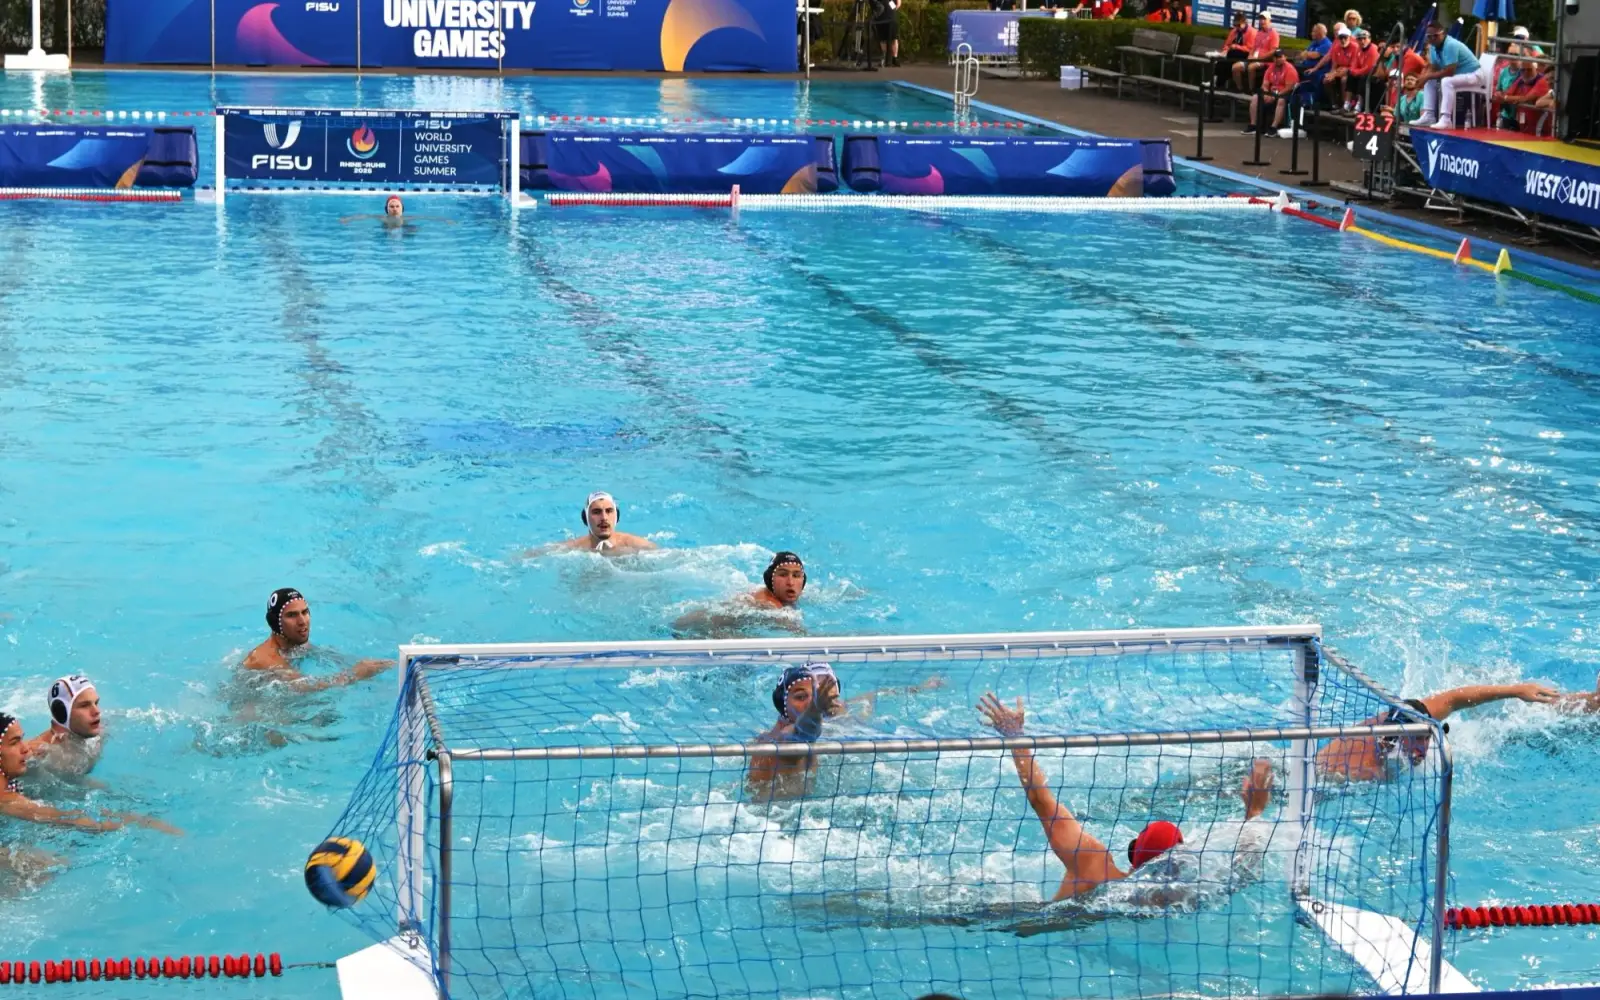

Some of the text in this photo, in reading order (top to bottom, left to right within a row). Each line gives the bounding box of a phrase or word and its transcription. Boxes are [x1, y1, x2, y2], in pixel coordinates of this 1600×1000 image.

[305, 2, 340, 12] FISU
[383, 0, 536, 29] UNIVERSITY
[413, 29, 506, 58] GAMES
[414, 120, 452, 129] FISU
[1355, 114, 1394, 133] 23.7
[414, 132, 453, 141] WORLD
[414, 144, 472, 153] UNIVERSITY
[1365, 135, 1379, 156] 4
[252, 154, 313, 170] FISU
[414, 155, 449, 164] GAMES
[1440, 152, 1480, 179] macron
[413, 166, 457, 176] SUMMER
[1525, 169, 1562, 200] WEST
[51, 682, 60, 698] 6
